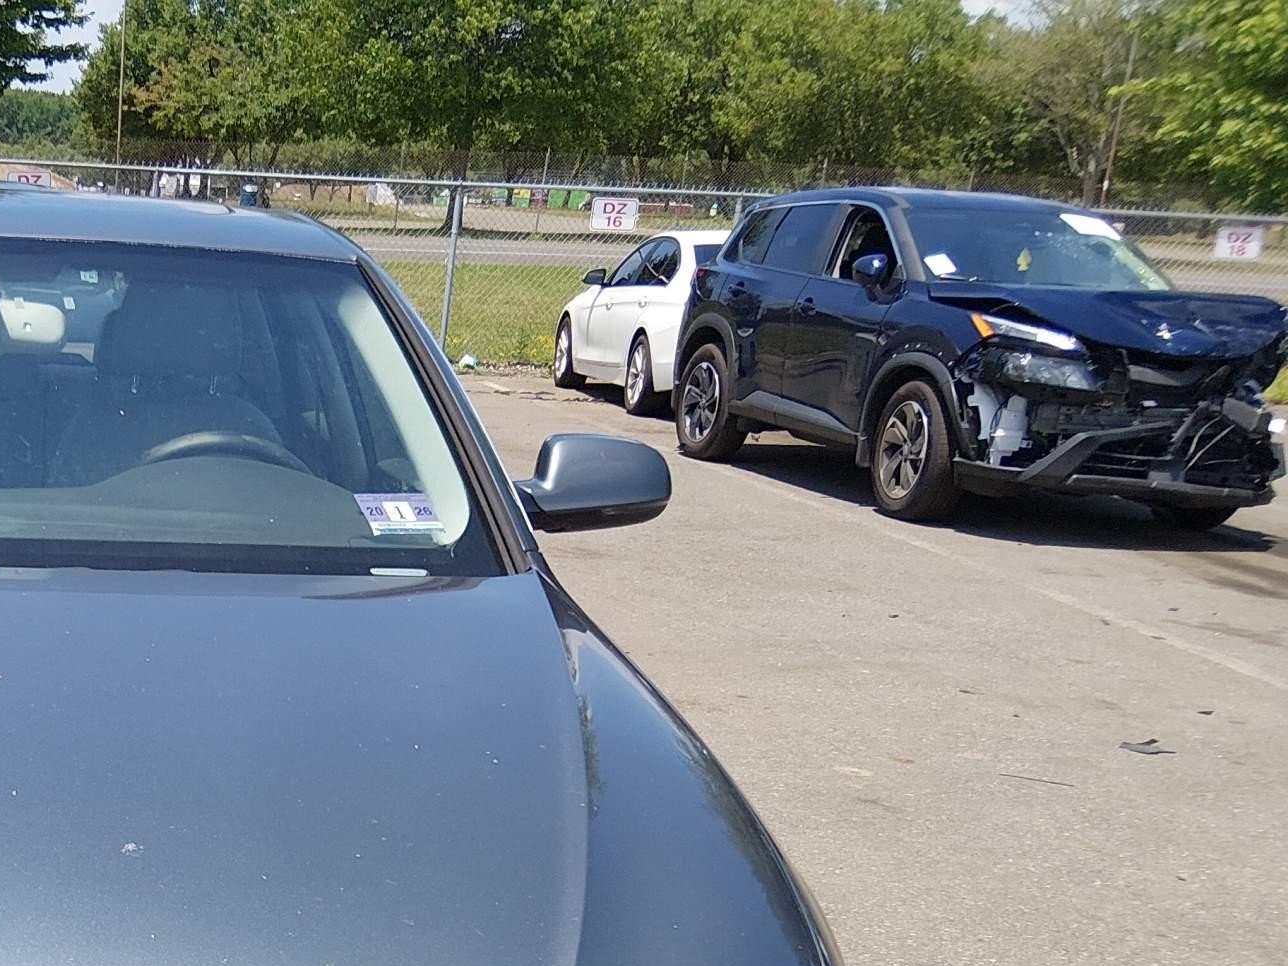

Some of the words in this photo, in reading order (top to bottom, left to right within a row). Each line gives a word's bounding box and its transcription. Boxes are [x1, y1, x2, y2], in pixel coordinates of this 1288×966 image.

[603, 202, 628, 215] DZ
[605, 215, 623, 228] 16
[1227, 231, 1253, 244] DZ
[366, 506, 384, 517] 20
[394, 505, 407, 520] 1
[414, 506, 433, 517] 26
